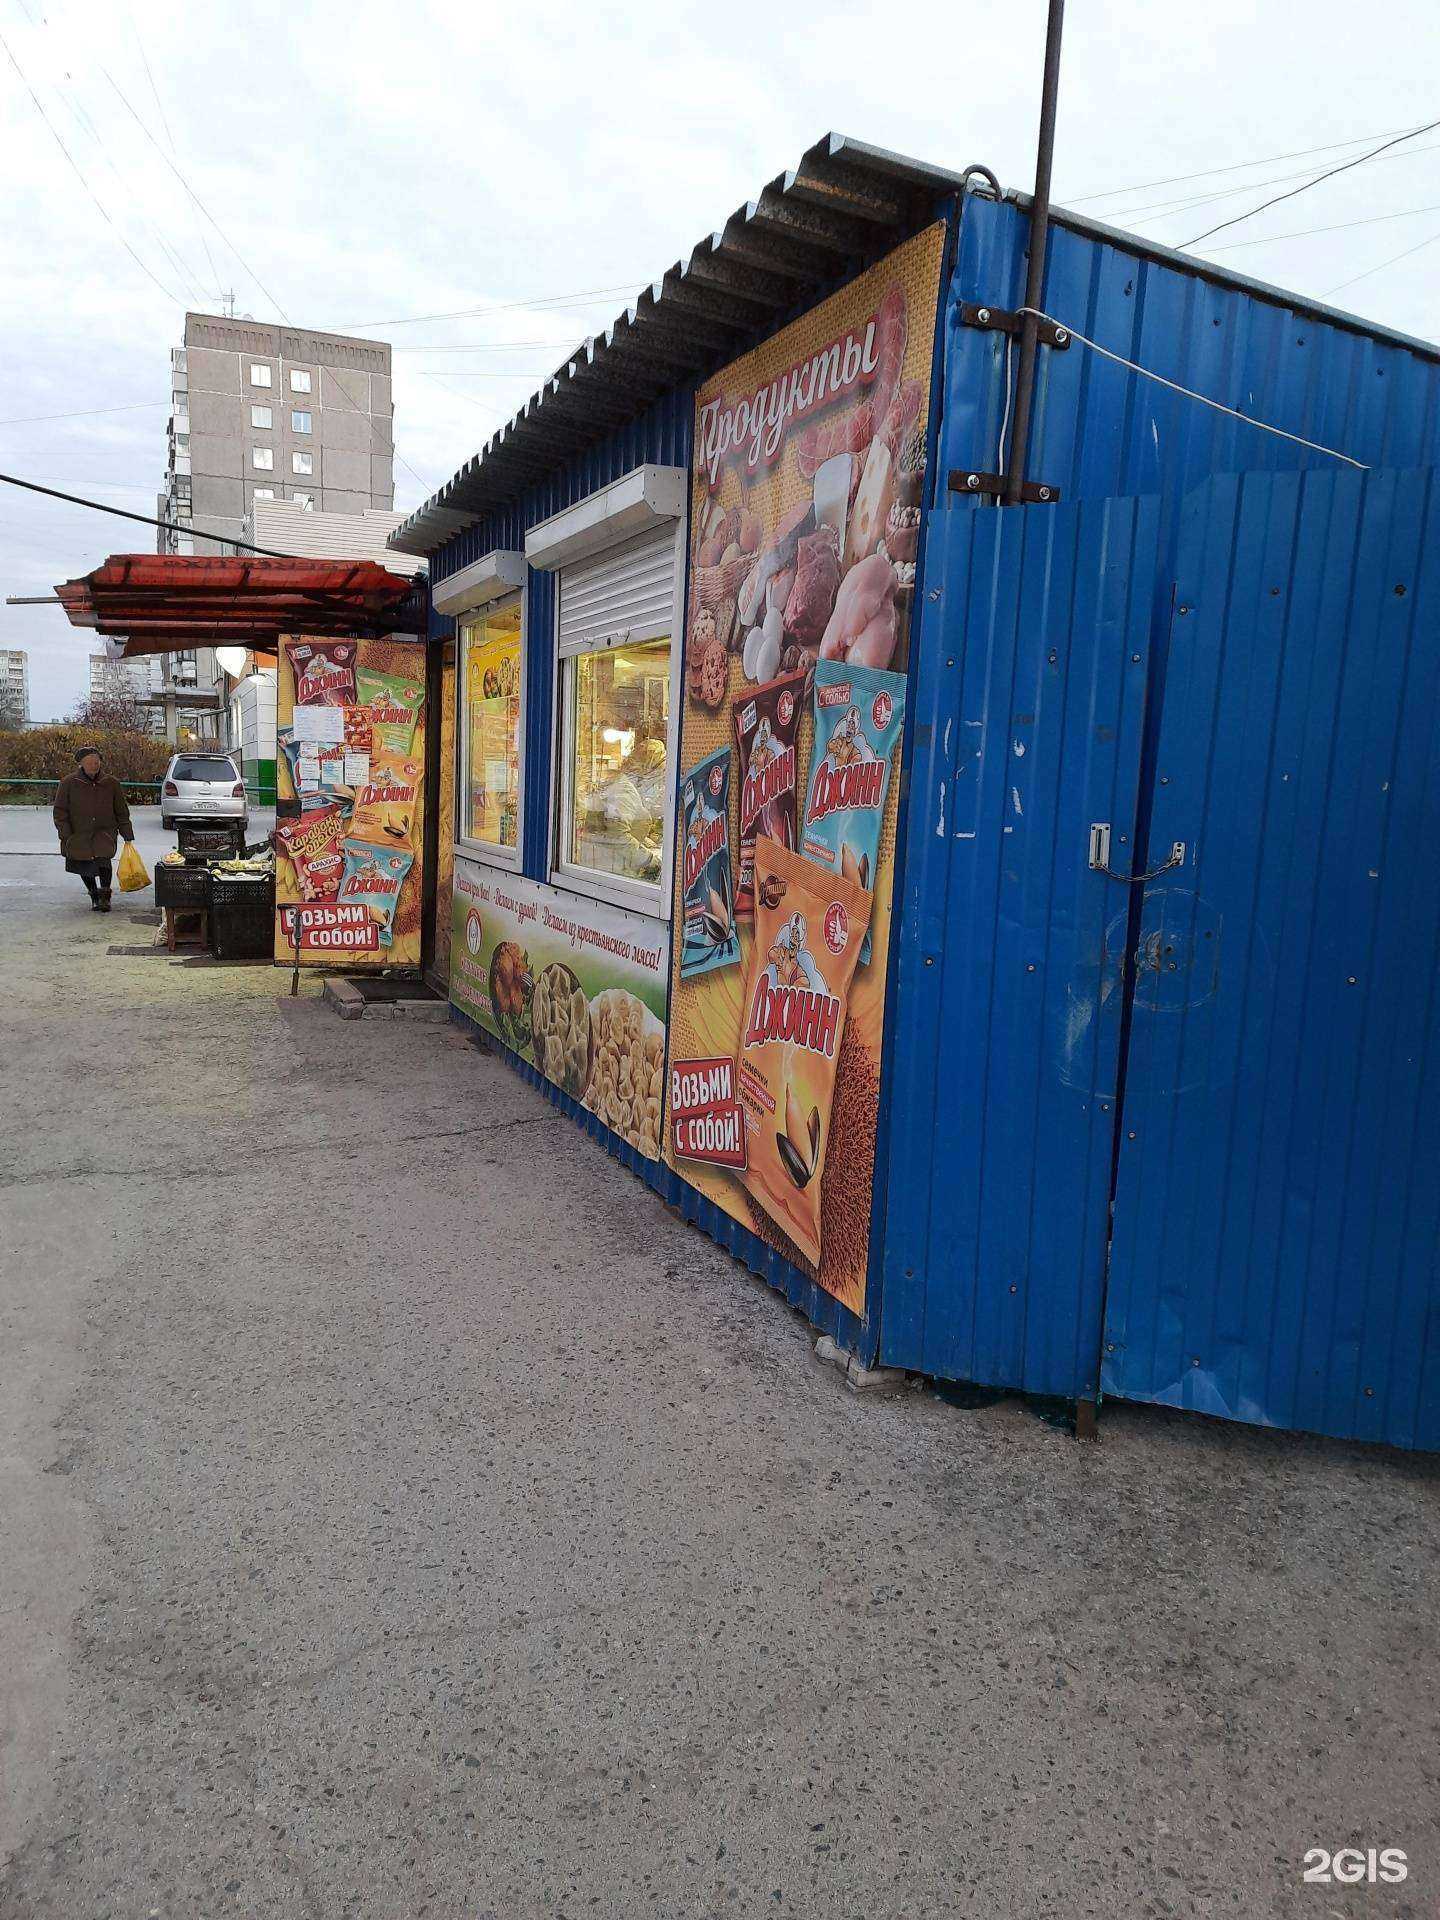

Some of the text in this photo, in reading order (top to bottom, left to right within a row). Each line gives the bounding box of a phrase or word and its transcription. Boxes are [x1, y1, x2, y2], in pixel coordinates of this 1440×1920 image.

[700, 321, 880, 486] Продукты
[577, 925, 631, 959] крестьянского
[631, 945, 662, 972] мяса!
